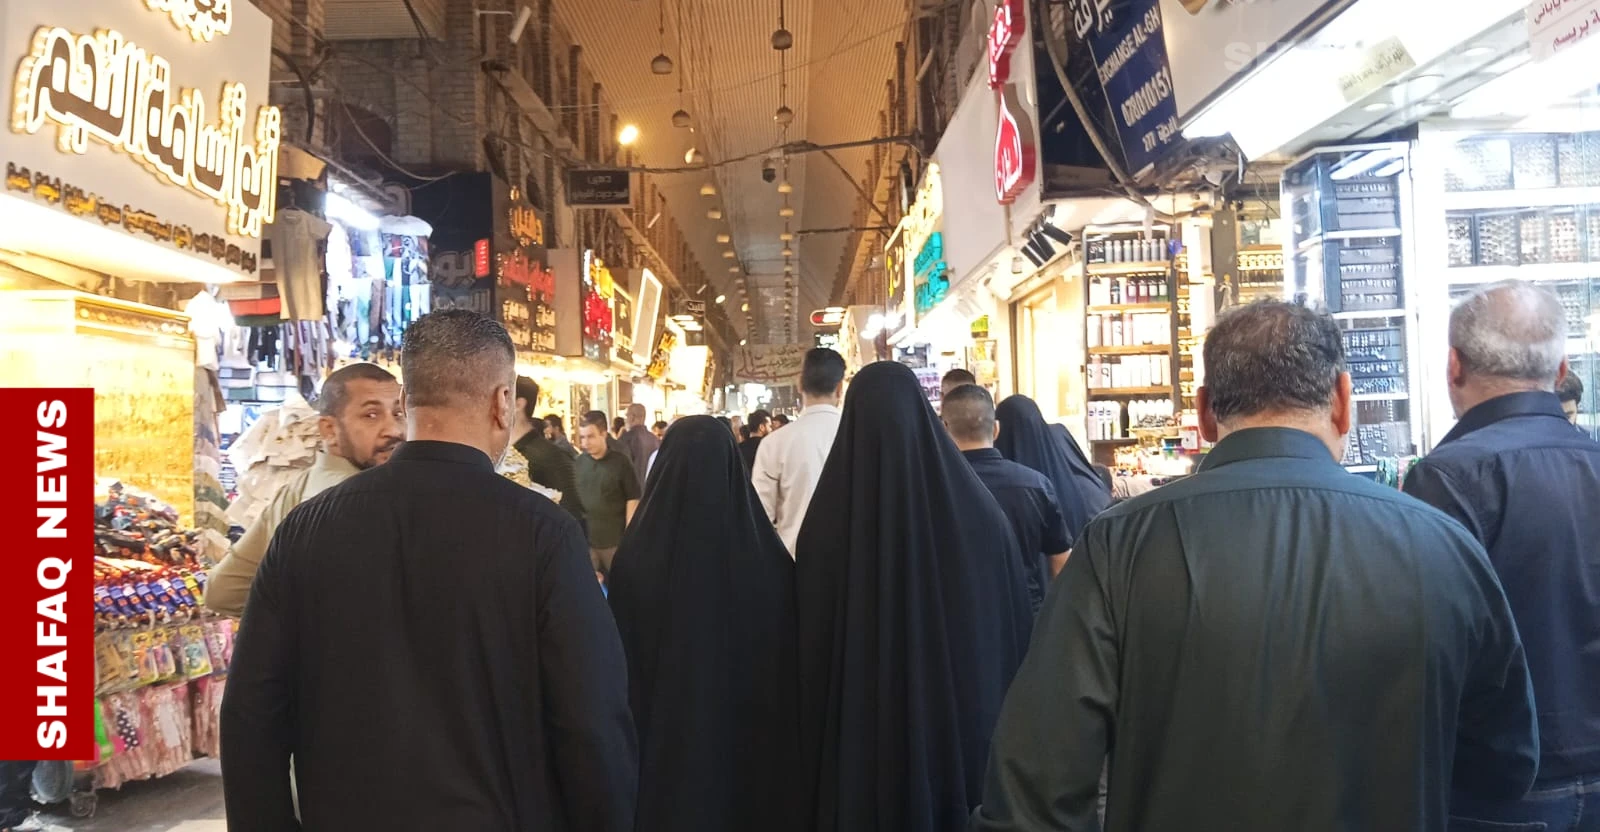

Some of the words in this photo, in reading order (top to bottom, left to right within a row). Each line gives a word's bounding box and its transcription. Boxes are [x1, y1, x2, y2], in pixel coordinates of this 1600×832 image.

[22, 27, 150, 155] النجم
[1098, 33, 1137, 87] EXCHANGE
[142, 56, 248, 206] أسامة
